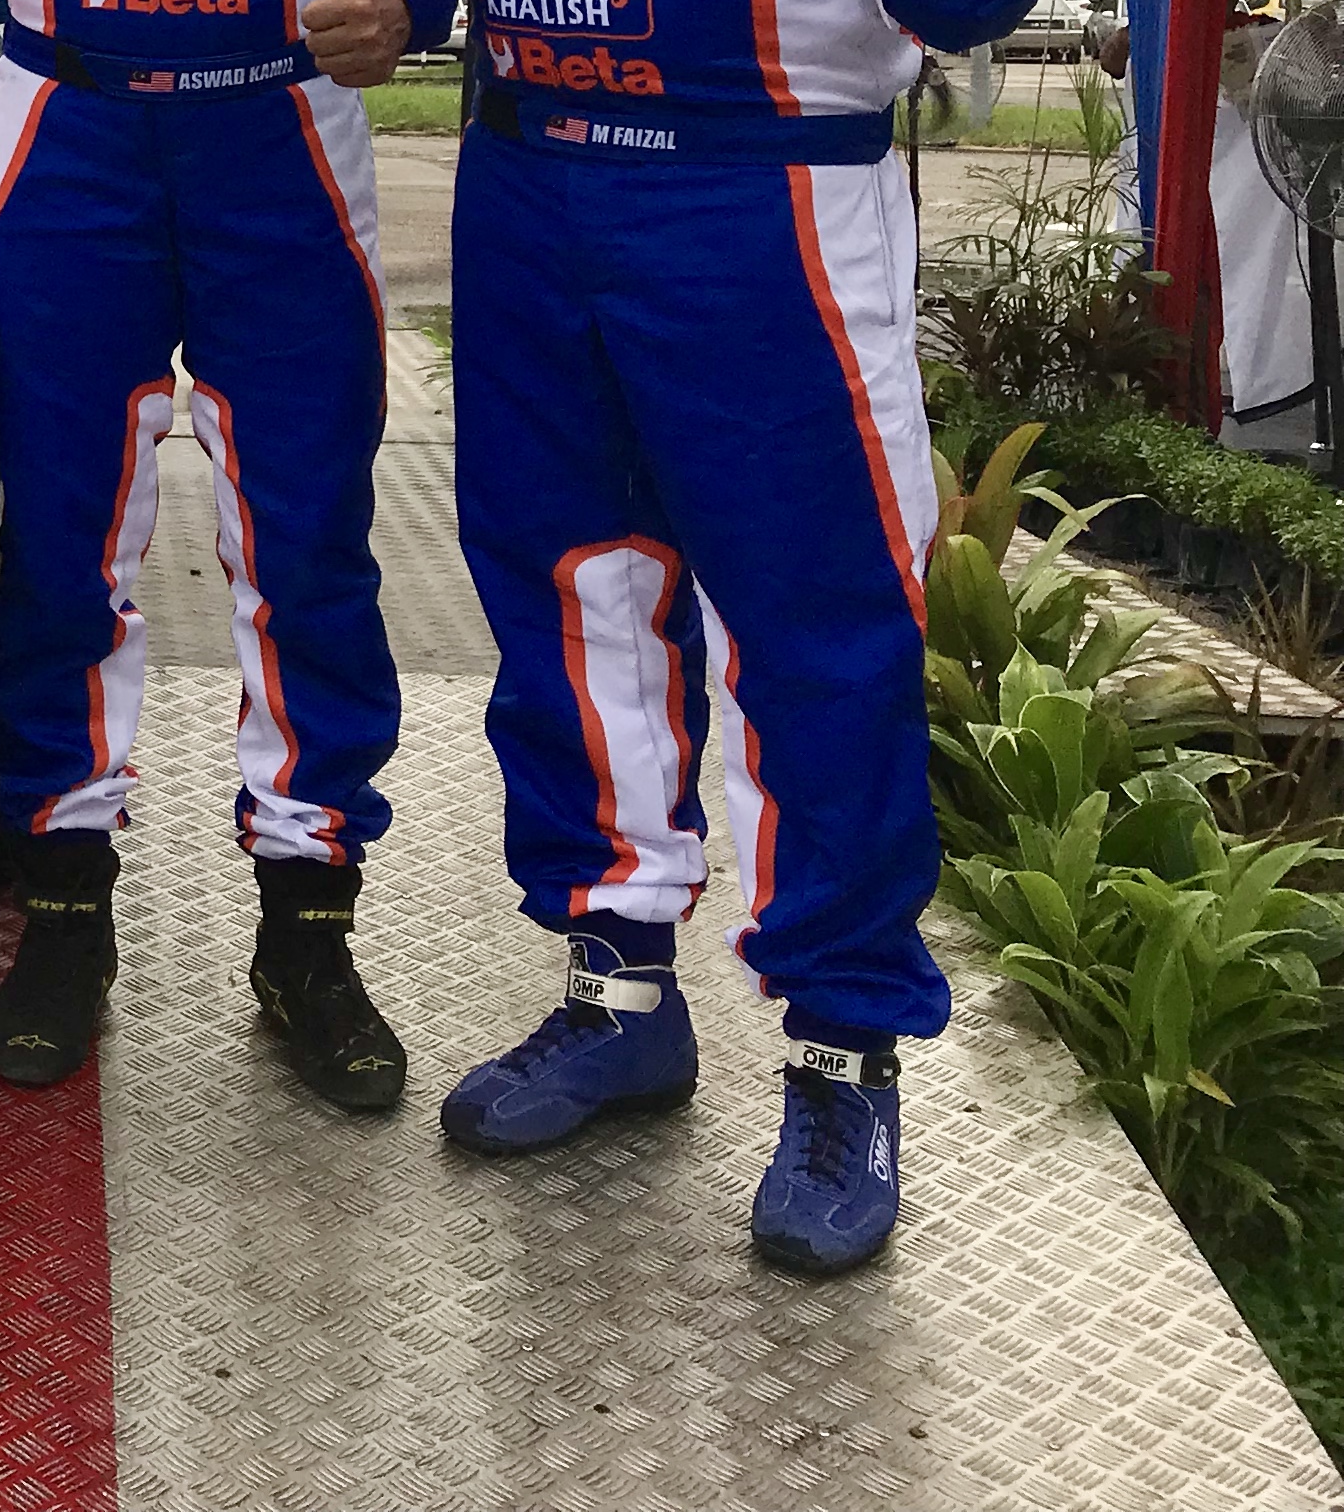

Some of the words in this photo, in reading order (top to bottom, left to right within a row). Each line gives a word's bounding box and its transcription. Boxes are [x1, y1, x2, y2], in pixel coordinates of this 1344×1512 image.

[179, 70, 244, 90] ASWAD
[249, 56, 294, 84] KAMIL
[517, 37, 663, 95] Beta
[592, 124, 609, 143] M
[614, 127, 676, 150] FAIZAL
[573, 978, 604, 997] OMP
[803, 1050, 847, 1073] OMP
[874, 1124, 892, 1182] OMP
